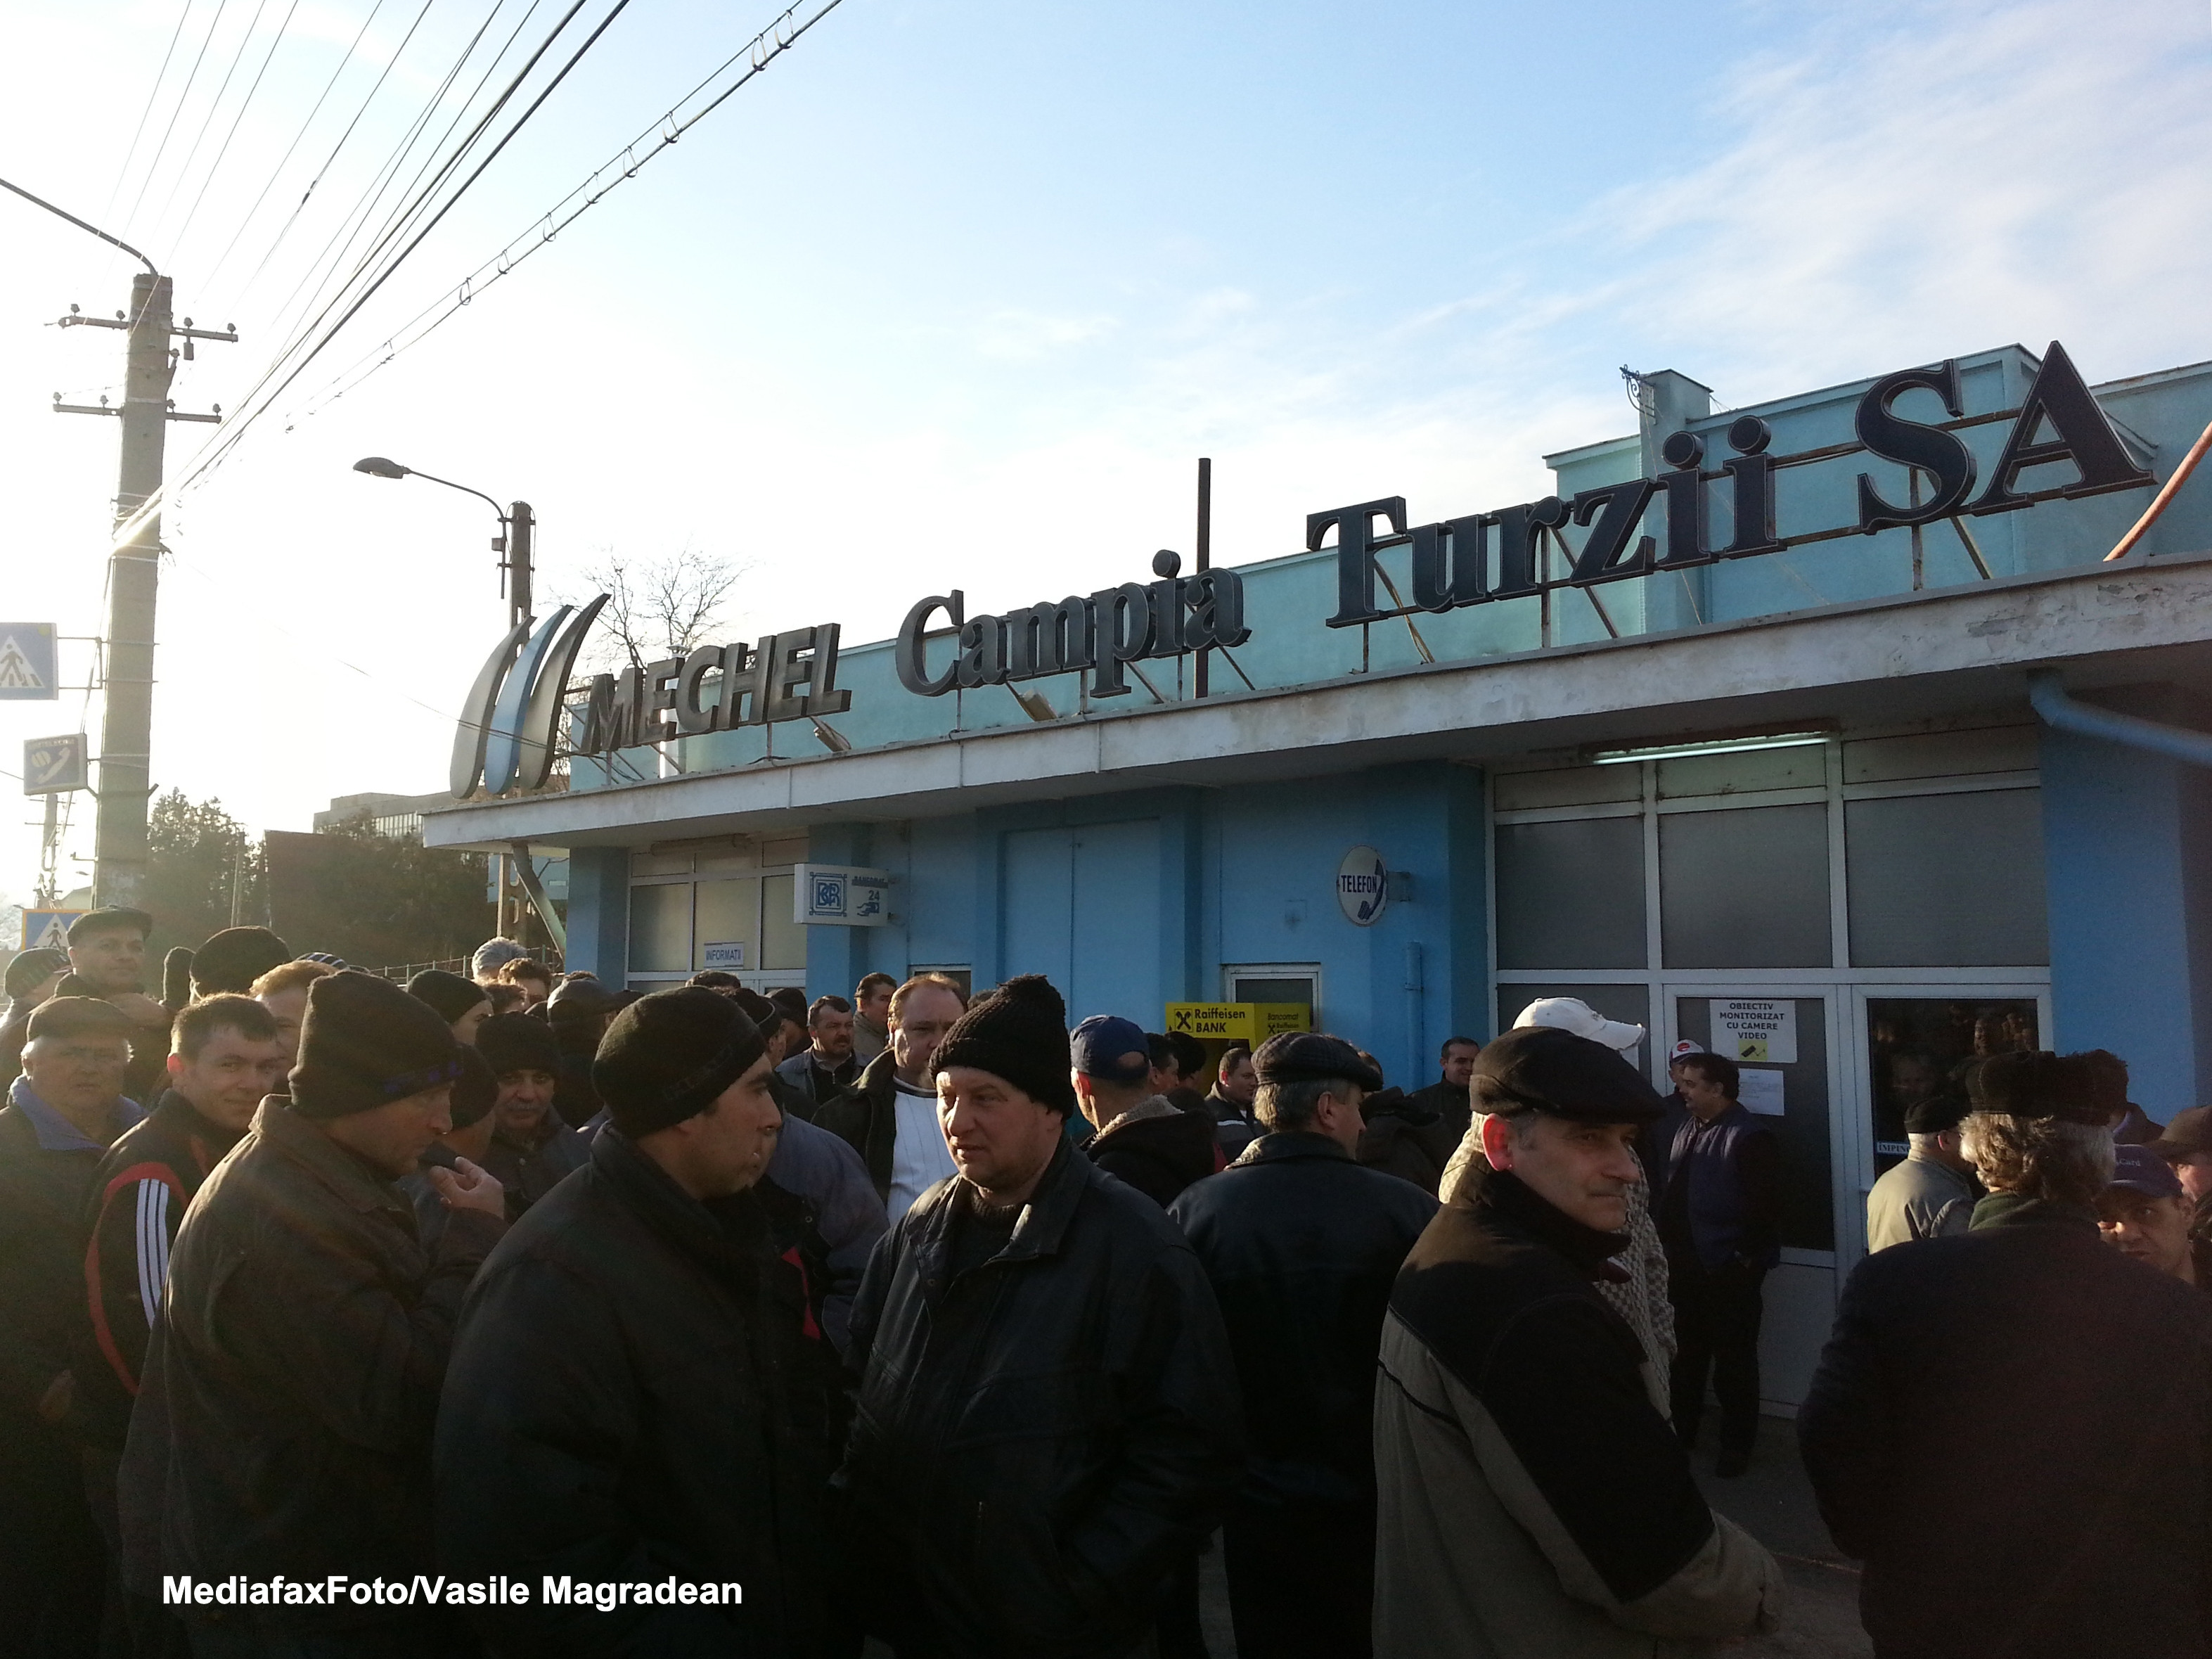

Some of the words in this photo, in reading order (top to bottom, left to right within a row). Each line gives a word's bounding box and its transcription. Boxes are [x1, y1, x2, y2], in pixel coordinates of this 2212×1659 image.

[581, 622, 851, 754] MECHEL
[896, 549, 1252, 698] Campia
[1306, 415, 1785, 627] Turzii
[1856, 340, 2157, 534] SA
[1341, 875, 1377, 893] TELEFON
[868, 890, 880, 901] 24
[1195, 1008, 1245, 1019] Raiffeisen
[1196, 1023, 1226, 1032] BANK
